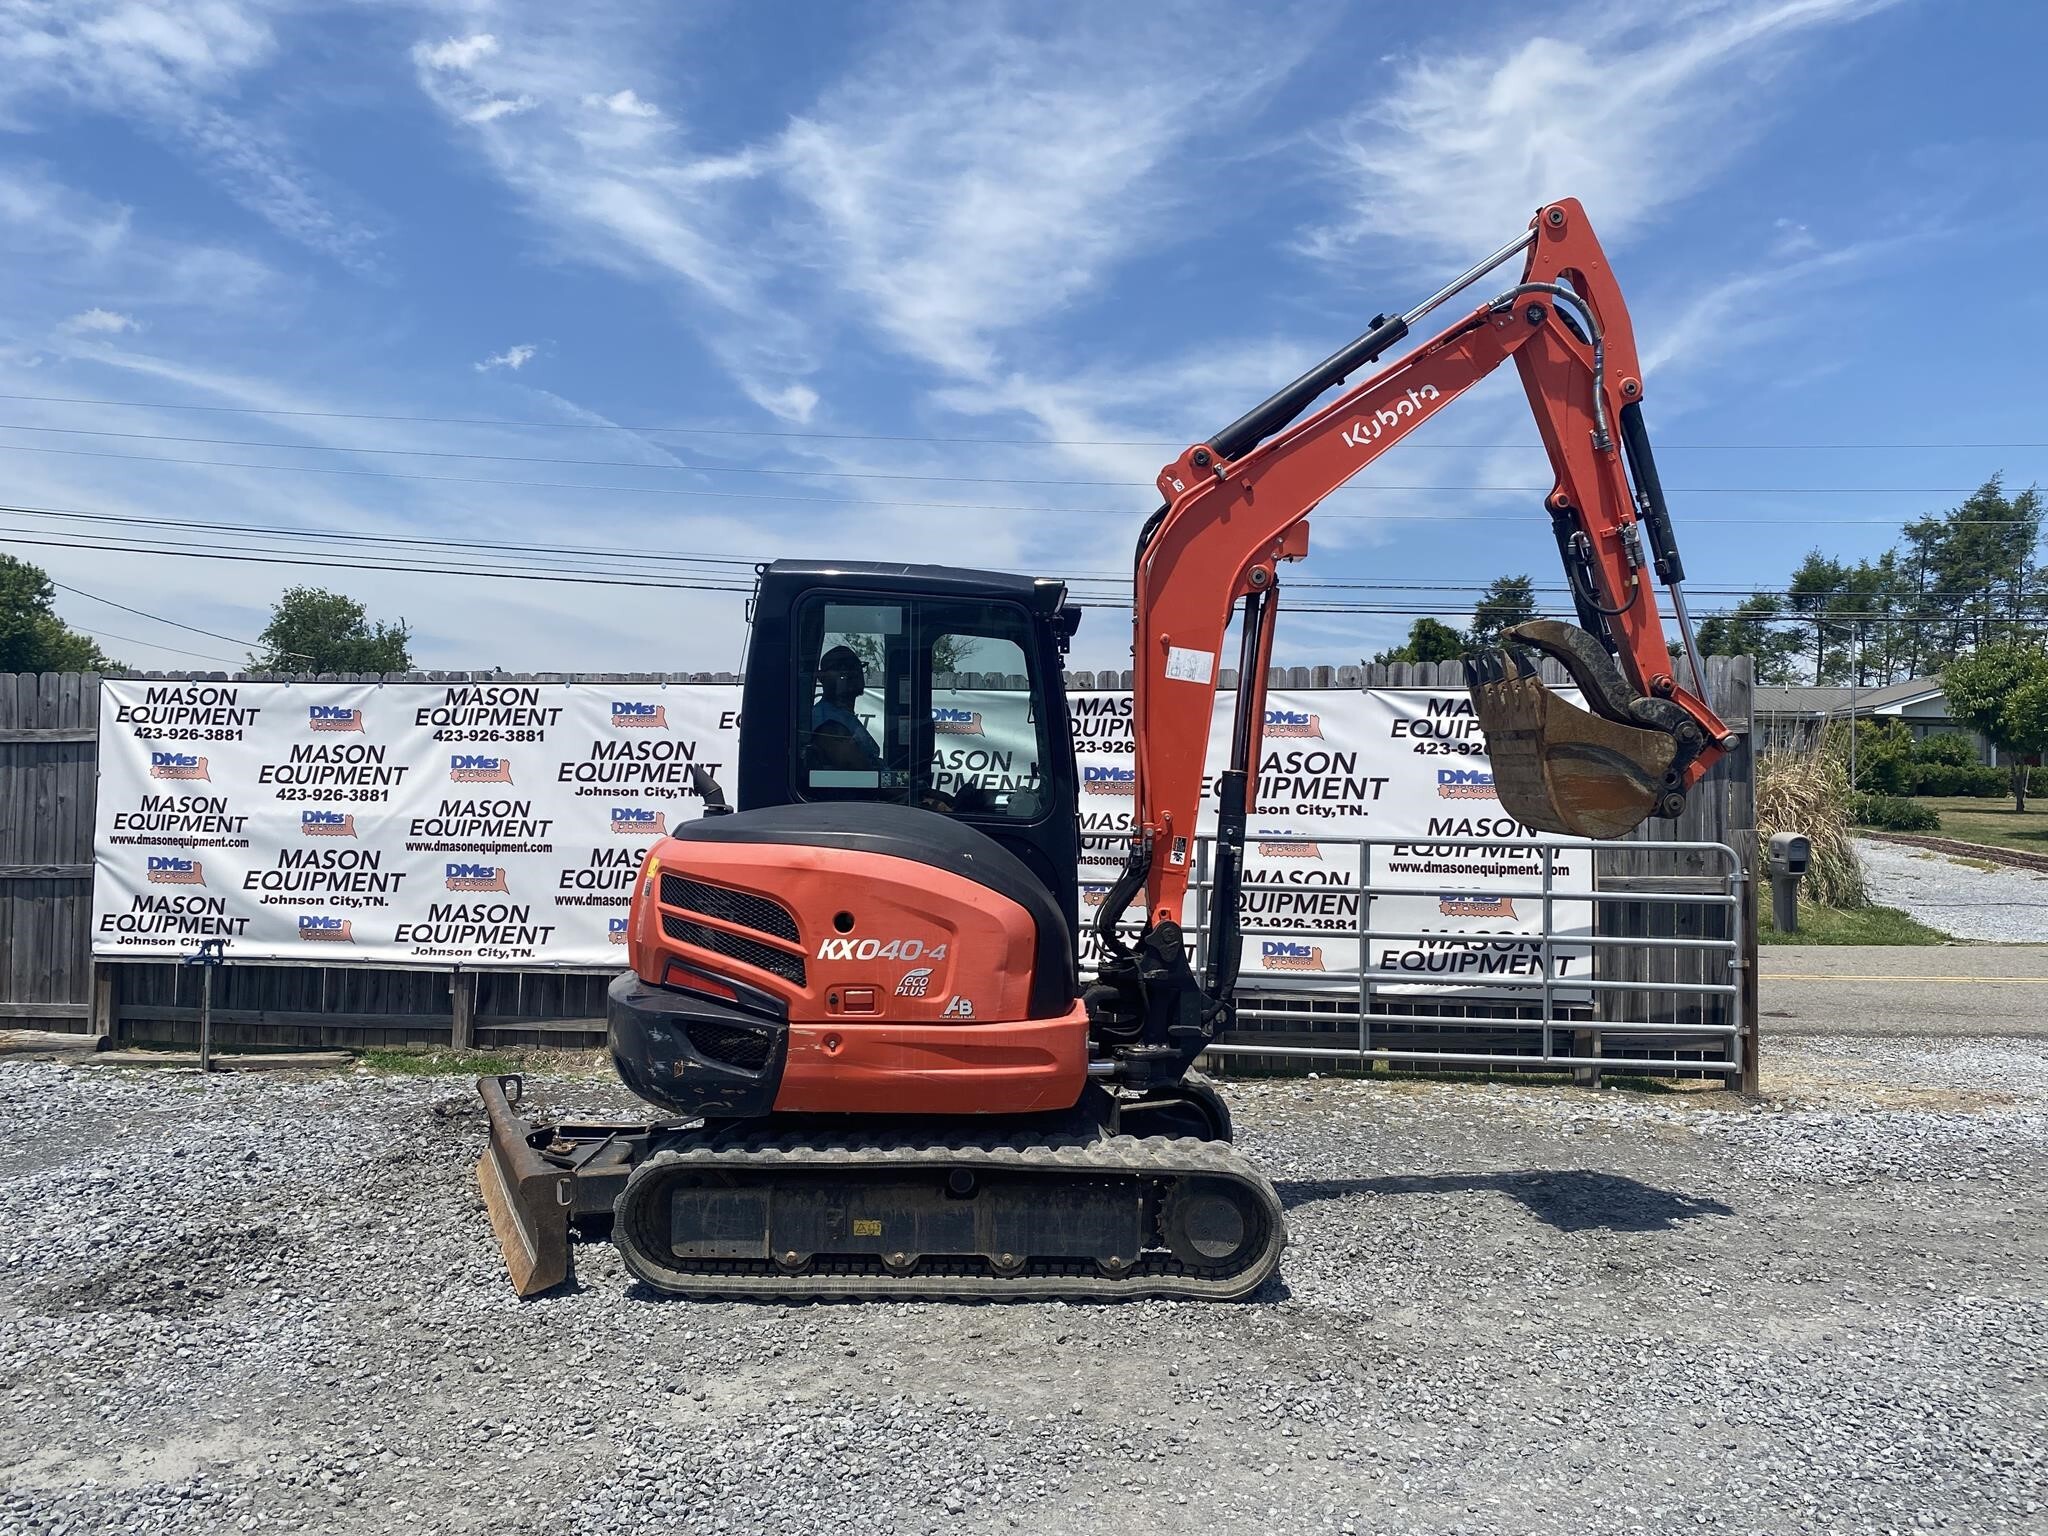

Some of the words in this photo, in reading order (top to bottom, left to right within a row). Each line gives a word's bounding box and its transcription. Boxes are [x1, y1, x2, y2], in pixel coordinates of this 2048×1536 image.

[1341, 384, 1440, 448] Kubota
[145, 688, 238, 706] MASON
[445, 688, 539, 706] MASON
[116, 706, 260, 726] EQUIPMENT
[1076, 698, 1133, 716] MAS
[415, 707, 562, 727] EQUIPMENT
[134, 727, 243, 741] 423-926-3881
[433, 730, 544, 742] 423-926-3881
[1391, 719, 1483, 739] EQUIP
[289, 745, 385, 764] MASON
[591, 741, 696, 761] MASON
[1075, 741, 1135, 753] 23-926
[931, 750, 1012, 771] ASON
[1259, 751, 1357, 774] ASON
[258, 765, 408, 785] EQUIPMENT
[558, 762, 722, 783] EQUIPMENT
[276, 788, 388, 802] 423-926-3881
[575, 786, 639, 796] Johnson
[1200, 776, 1389, 800] EIPMENT
[140, 795, 228, 814] MASON
[439, 800, 531, 818] MASON
[1295, 804, 1369, 818] City,TN.
[113, 813, 248, 833] EQUIPMENT
[410, 819, 553, 838] EQUIPMENT
[1080, 812, 1131, 831] MAS
[1427, 817, 1538, 838] MASON
[110, 835, 249, 847] www.dmasonequipment.com
[406, 841, 552, 853] www.dmasonequipment.com
[278, 850, 381, 870] MASON
[590, 849, 647, 868] MAS
[1389, 861, 1570, 877] www.dmasonequipment.om
[243, 871, 406, 892] EQUIPMENT
[559, 870, 636, 890] EQUIP
[131, 895, 225, 915] MASON
[260, 895, 323, 905] Johnson
[329, 896, 389, 907] City,TN.
[428, 904, 530, 923] MASON
[1240, 916, 1357, 930] 23-926-3881
[100, 914, 250, 936] EQUIPMENT
[394, 924, 555, 945] EQUIPMENT
[116, 936, 175, 946] Johnson
[816, 938, 947, 961] KX040-4
[411, 947, 475, 956] Johnson
[477, 947, 535, 959] City,TN.
[1380, 950, 1576, 976] EQUIPMENT
[894, 986, 927, 997] PLUS
